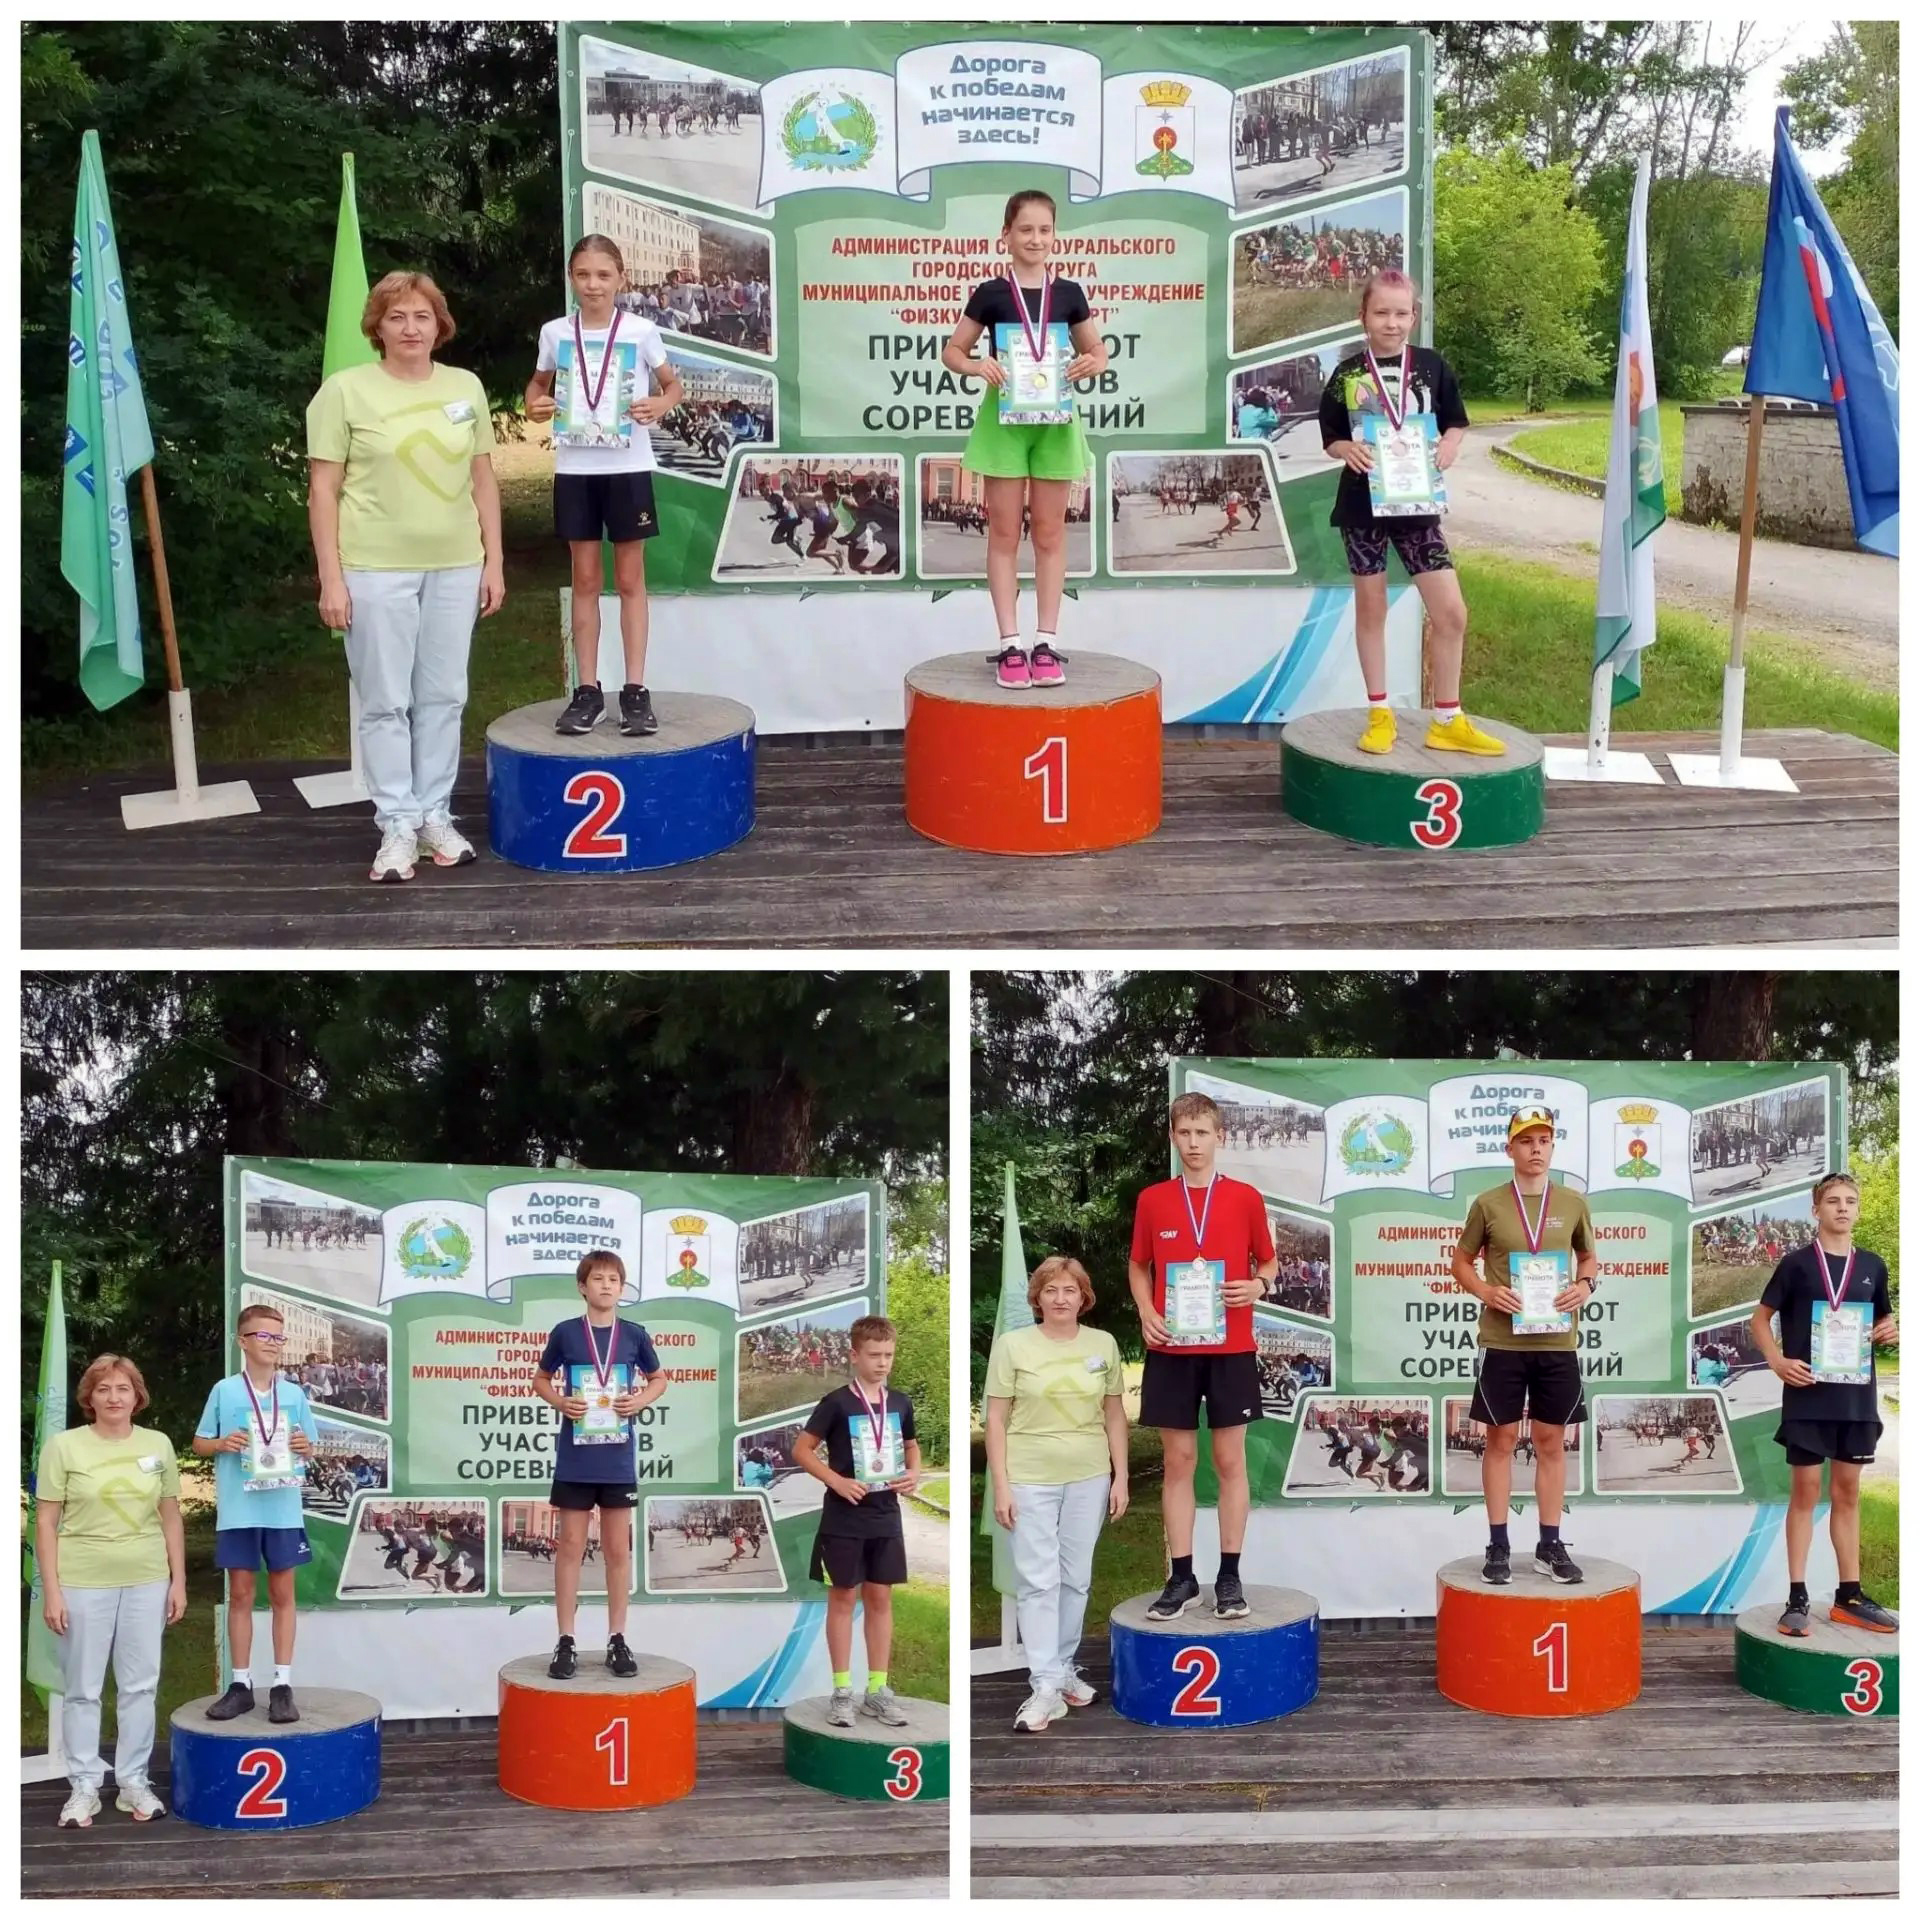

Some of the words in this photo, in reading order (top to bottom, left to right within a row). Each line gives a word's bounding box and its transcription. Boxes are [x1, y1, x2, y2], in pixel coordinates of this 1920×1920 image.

[950, 55, 1046, 75] Дорога
[930, 85, 947, 100] к
[952, 78, 1066, 101] победам
[921, 106, 1075, 127] начинается
[958, 127, 1040, 144] здесь!
[832, 238, 989, 258] АДМИНИСТРАЦИЯ
[803, 284, 962, 304] МУНИЦИПАЛЬНОЕ
[1087, 284, 1205, 304] УЧРЕЖДЕНИЕ
[1024, 737, 1068, 823] 1
[562, 770, 627, 858] 2
[1410, 778, 1463, 850] 3
[1470, 1084, 1545, 1101] Дорога
[1454, 1108, 1468, 1120] к
[527, 1191, 600, 1209] Дорога
[511, 1214, 525, 1226] к
[528, 1210, 615, 1229] победам
[505, 1231, 622, 1250] начинается
[412, 1365, 534, 1381] МУНИЦИПАЛЬНОЕ
[1532, 1622, 1568, 1692] 1
[1170, 1645, 1221, 1716] 2
[1841, 1658, 1884, 1717] 3
[594, 1717, 629, 1786] 1
[235, 1748, 287, 1819] 2
[883, 1746, 923, 1802] 3
